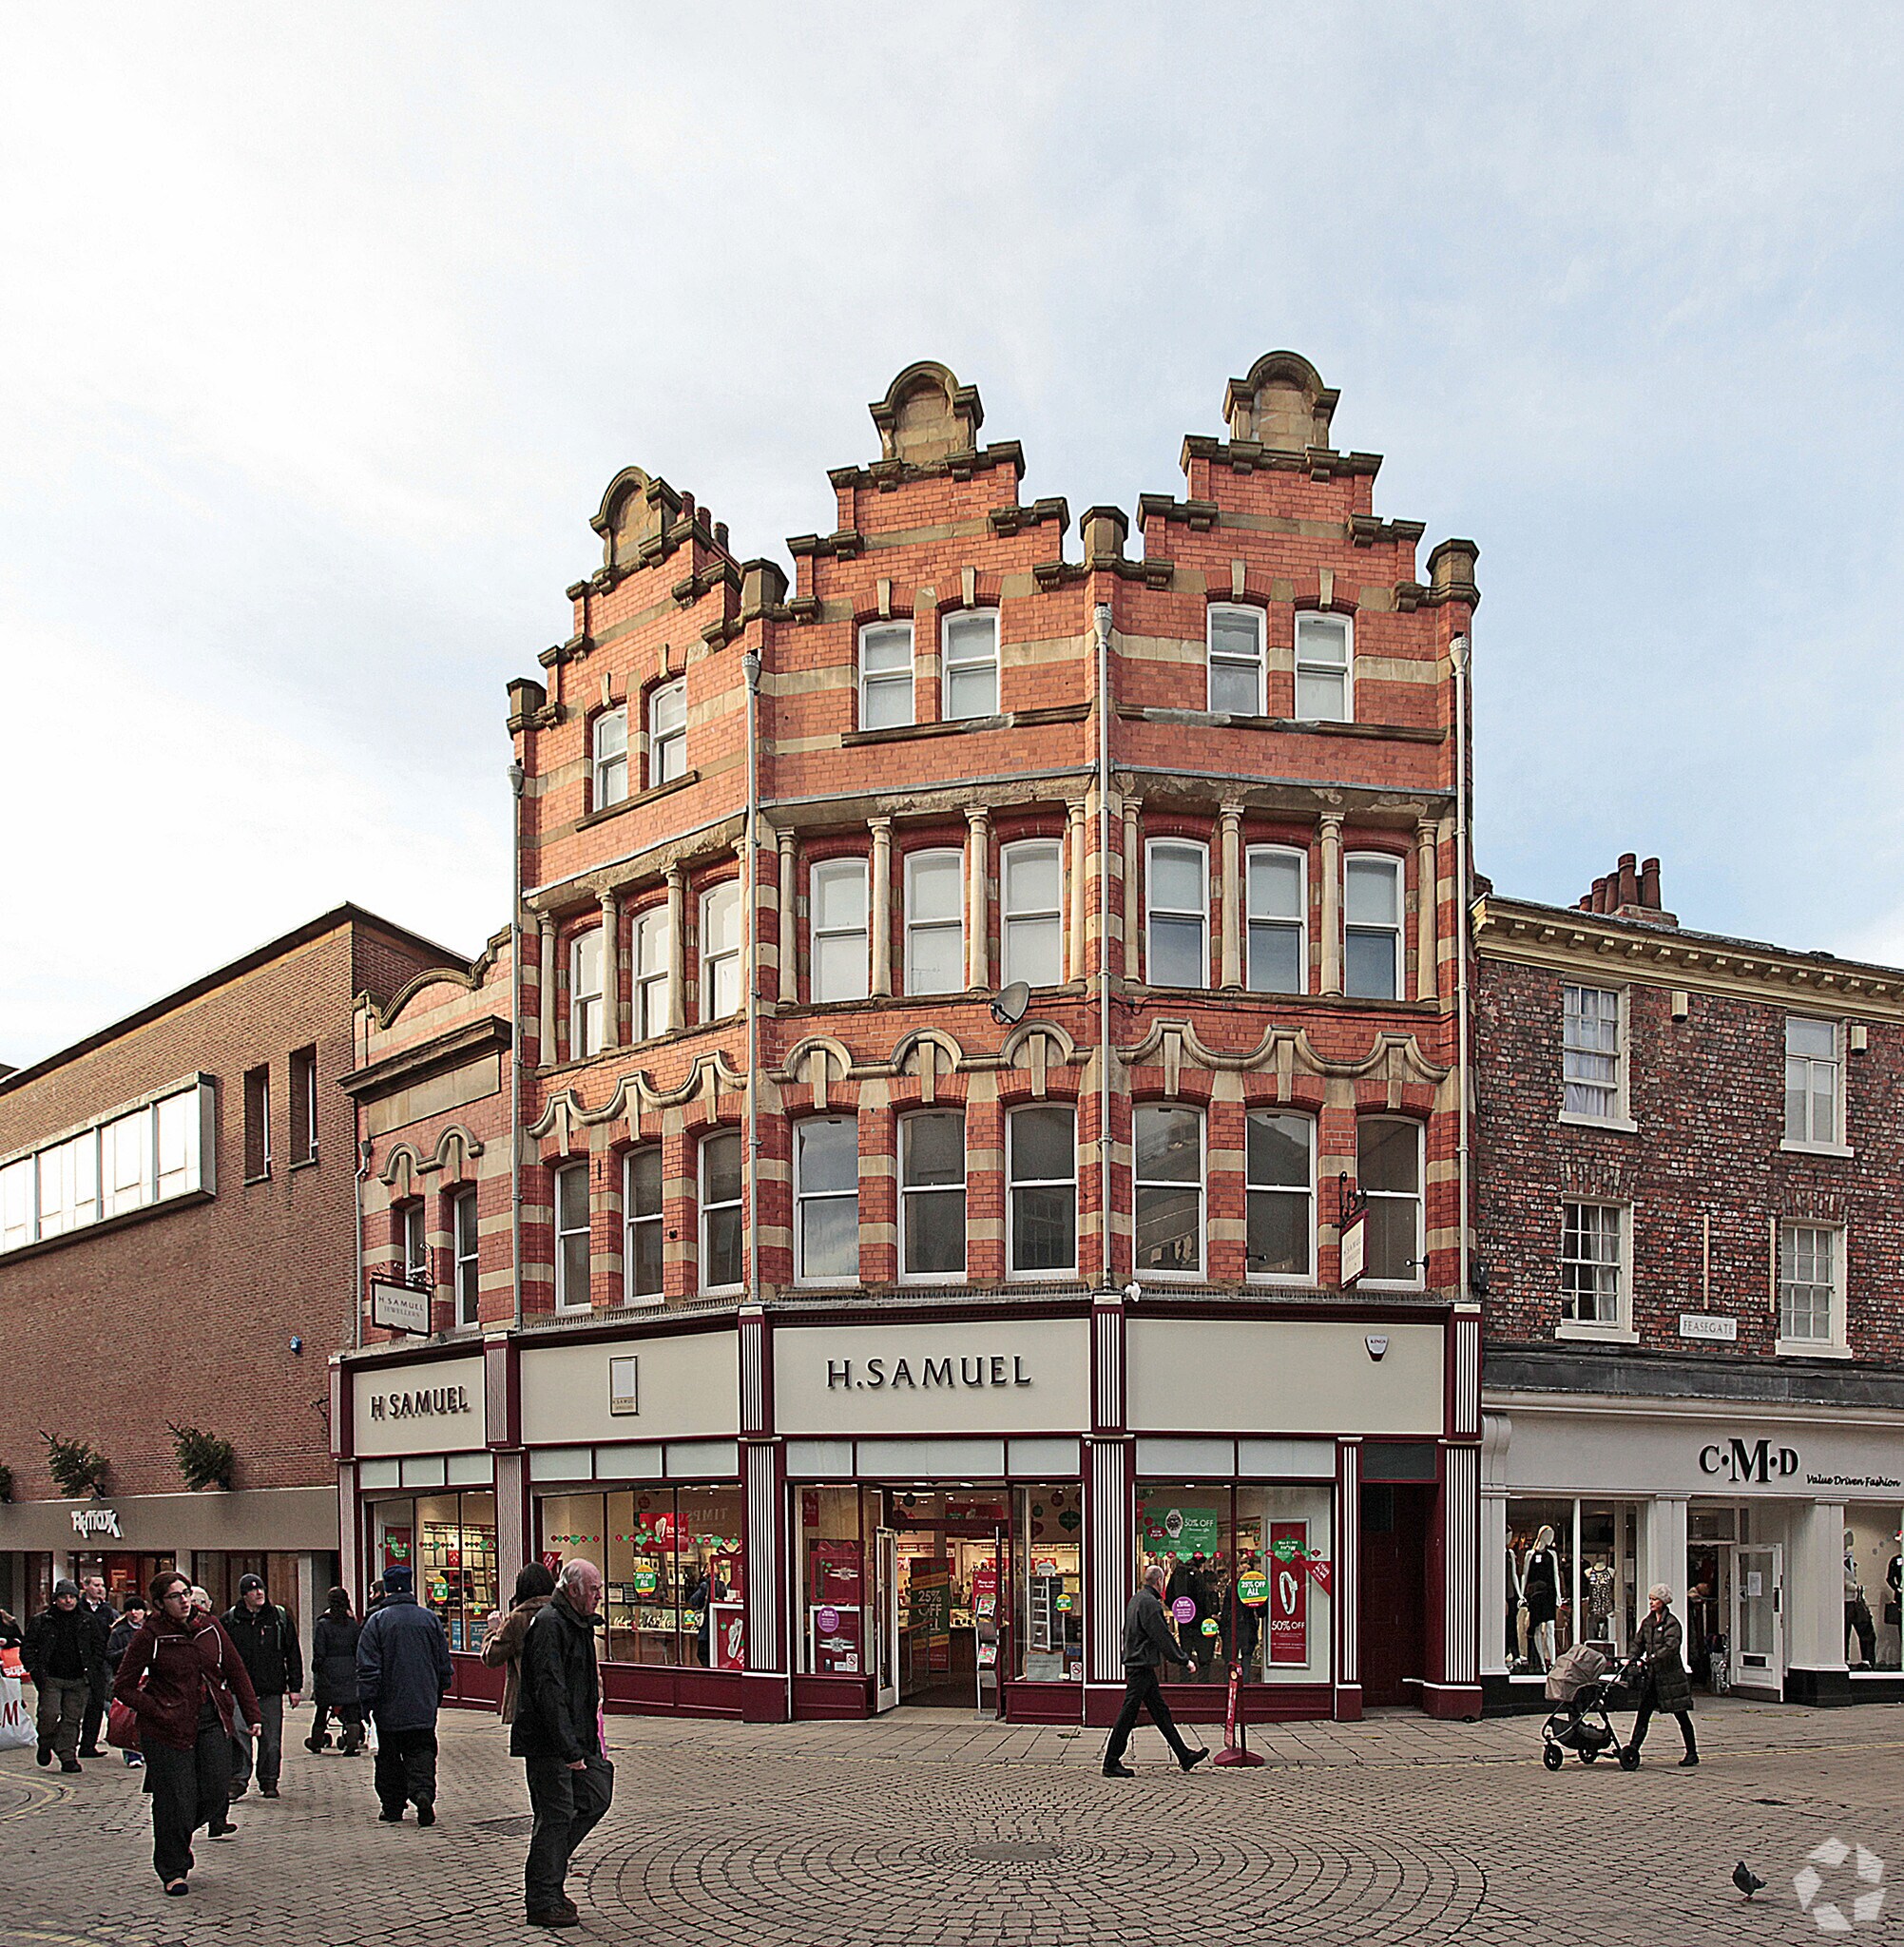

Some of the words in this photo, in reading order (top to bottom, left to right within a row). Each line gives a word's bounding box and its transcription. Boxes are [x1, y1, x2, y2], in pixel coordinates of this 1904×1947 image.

[388, 1298, 424, 1312] SAMUEL
[1683, 1319, 1734, 1335] FEASEGATE
[371, 1396, 384, 1419] H
[389, 1386, 470, 1417] SAMUEL
[1806, 1474, 1833, 1484] Value
[1834, 1475, 1864, 1486] Driven
[1865, 1476, 1901, 1488] Fashion
[918, 1590, 942, 1603] 25%
[1247, 1588, 1260, 1596] ALL
[1271, 1620, 1291, 1631] 50%
[1291, 1621, 1305, 1629] OFF
